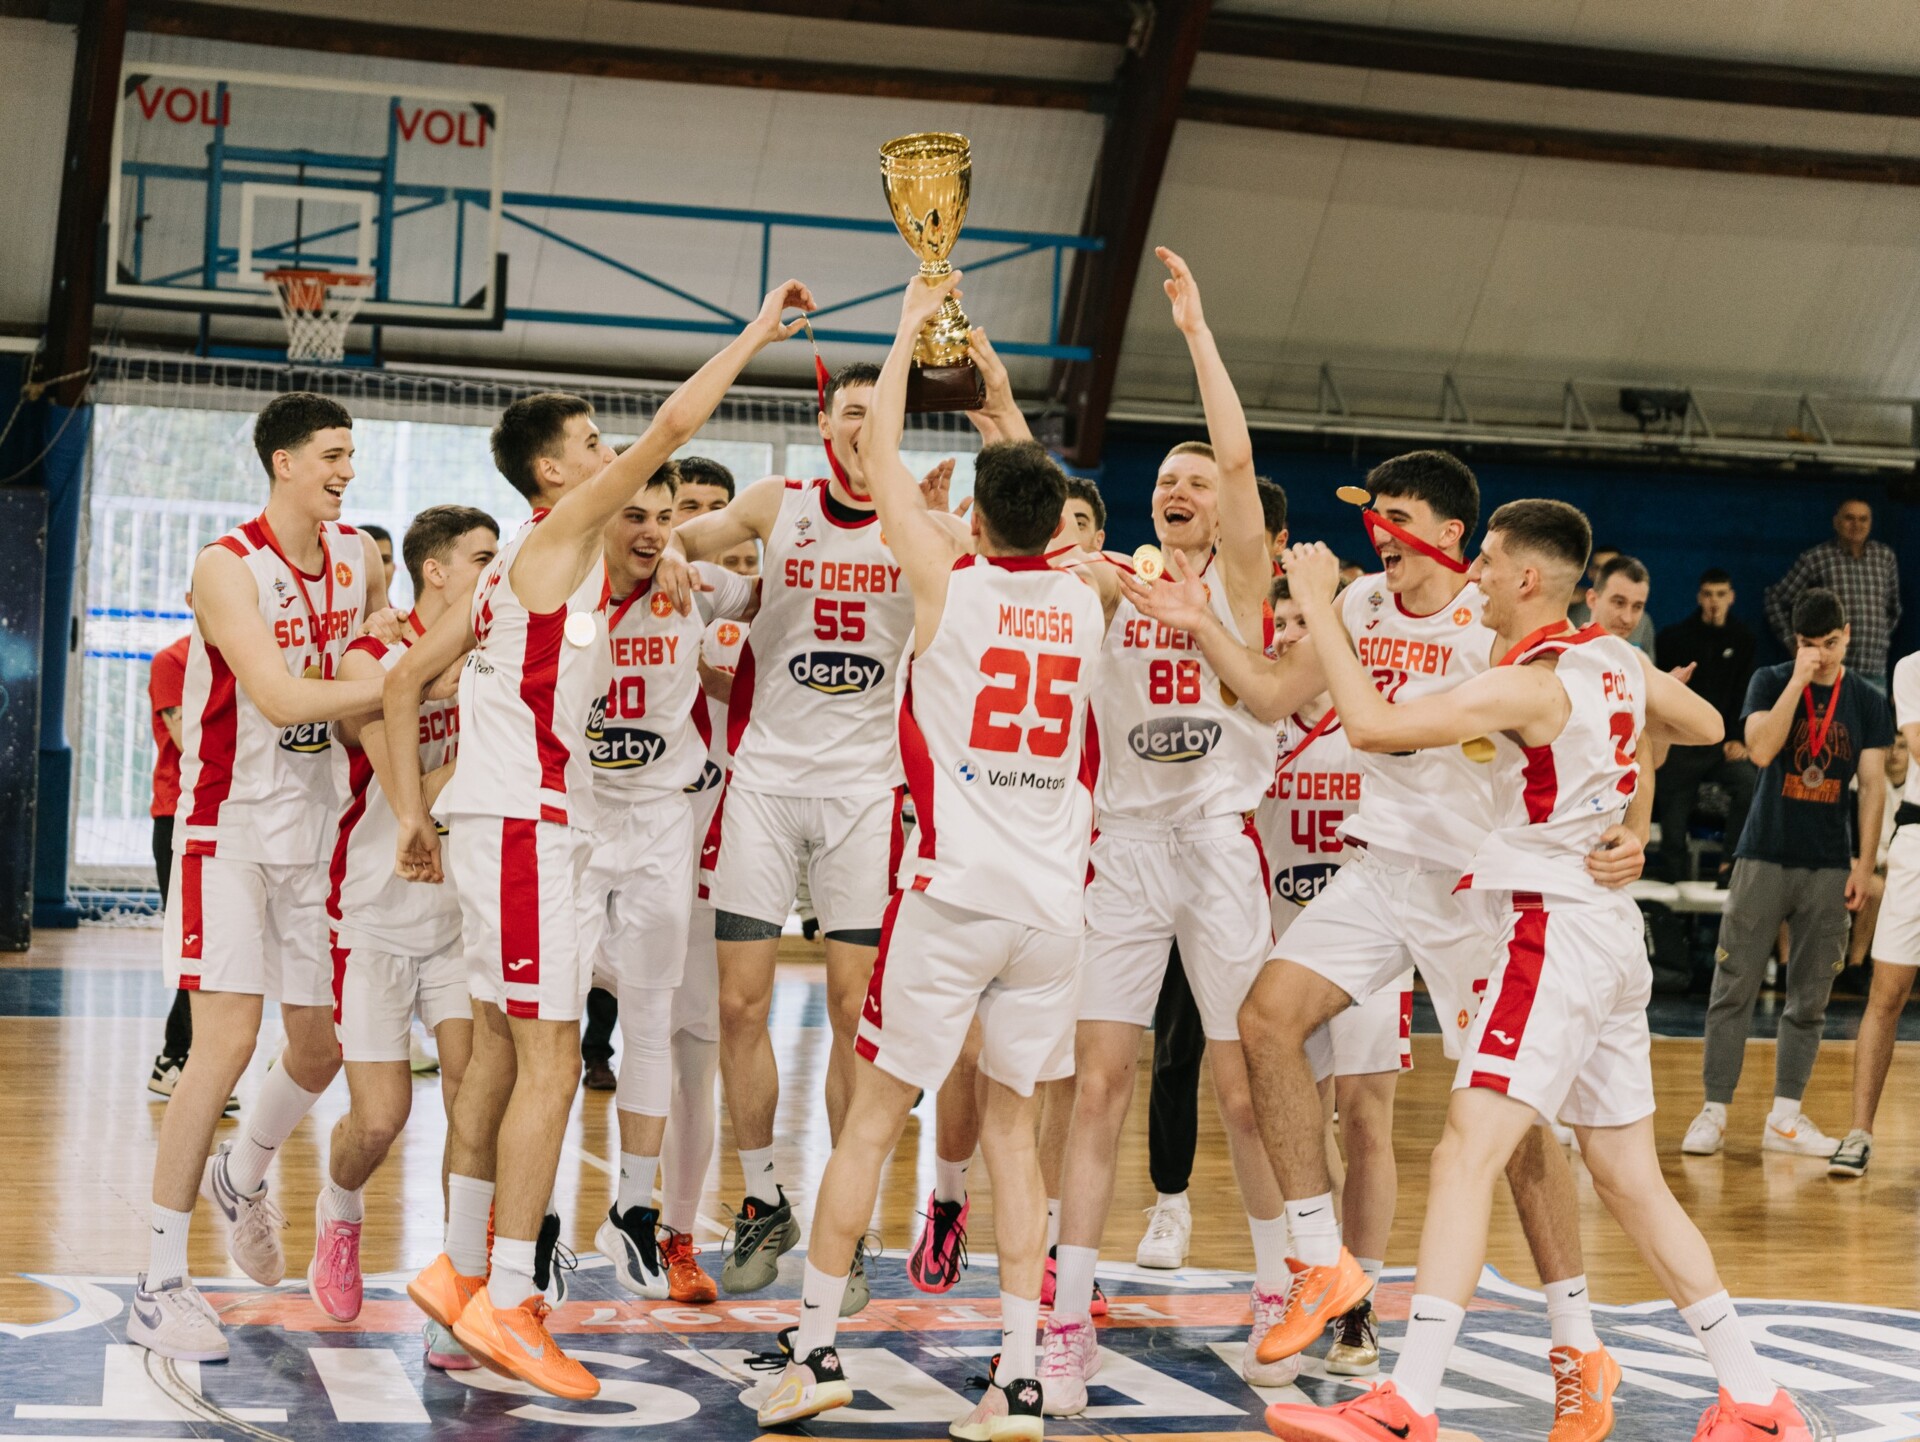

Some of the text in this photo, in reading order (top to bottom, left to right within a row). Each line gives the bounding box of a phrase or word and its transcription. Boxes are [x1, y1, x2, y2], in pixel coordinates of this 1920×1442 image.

[136, 84, 231, 127] VOLI
[395, 106, 487, 148] VOLI
[784, 558, 902, 593] SC DERBY
[274, 617, 306, 649] SC
[814, 598, 866, 642] 55
[998, 603, 1073, 645] MUGOŠA
[1122, 619, 1152, 649] SC
[609, 636, 679, 667] ERBY
[793, 652, 881, 693] derby
[1149, 659, 1201, 704] 88
[968, 646, 1082, 758] 25
[591, 732, 661, 764] erby
[1133, 721, 1218, 756] derby
[987, 770, 1018, 788] Voli
[1297, 772, 1365, 801] DERB
[1291, 809, 1344, 854] 45
